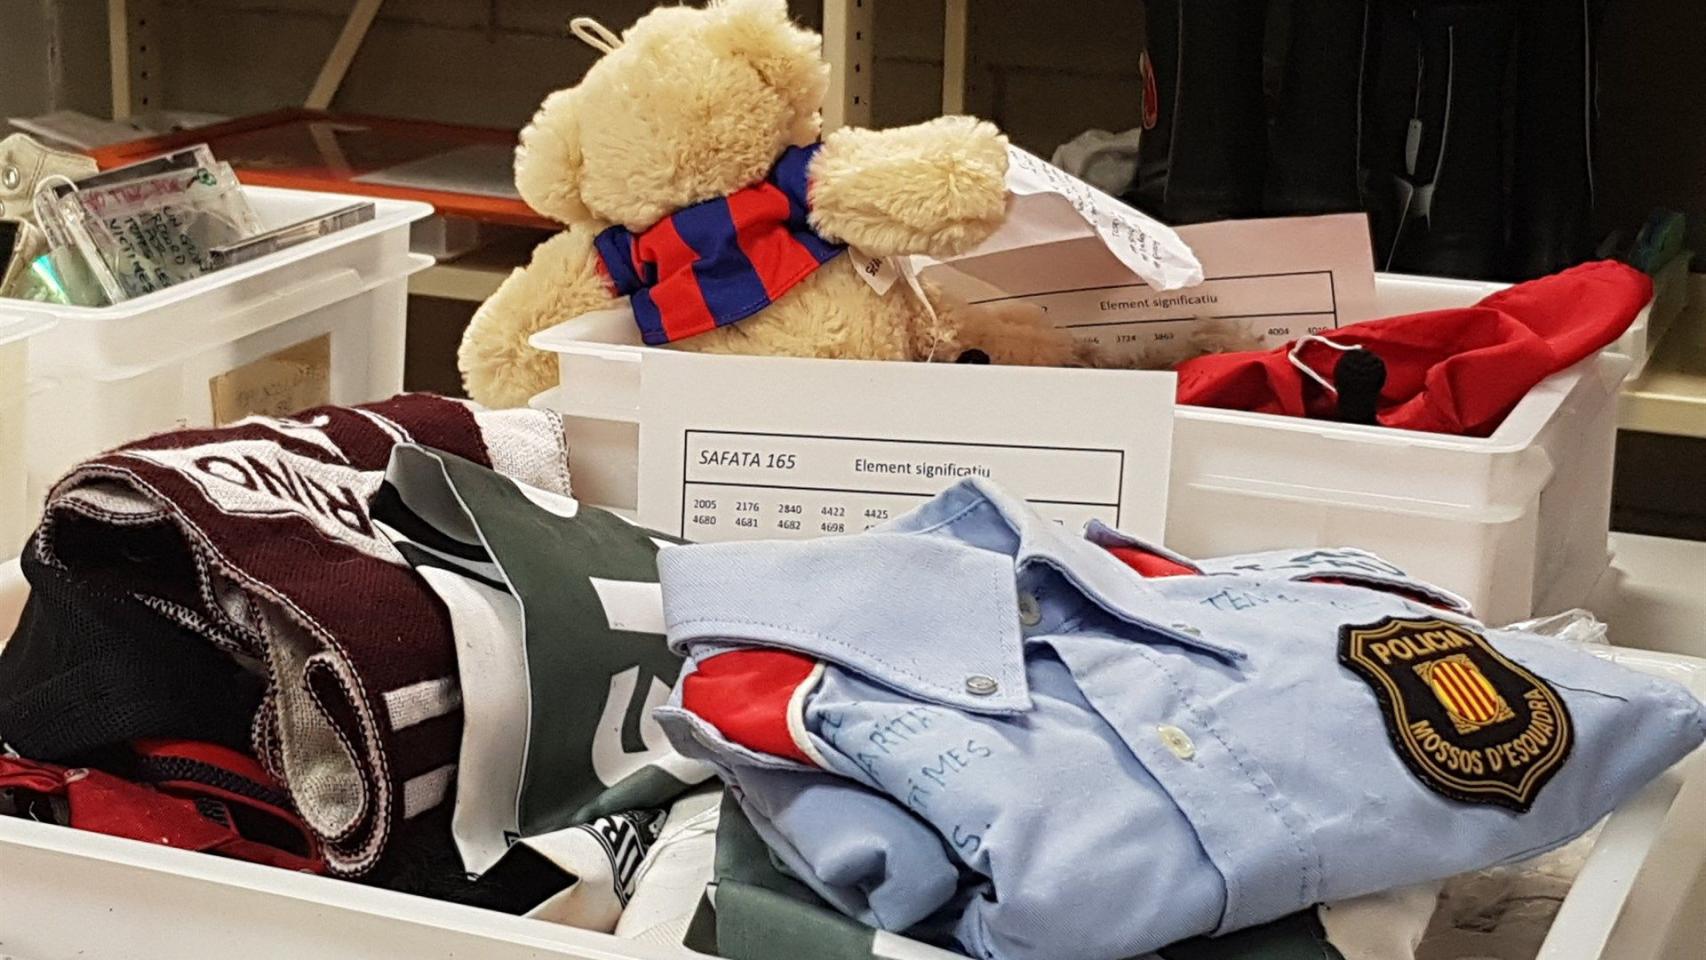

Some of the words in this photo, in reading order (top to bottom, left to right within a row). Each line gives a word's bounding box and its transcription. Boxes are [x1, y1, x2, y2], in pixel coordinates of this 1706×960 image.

[1100, 298, 1149, 311] Element
[1153, 294, 1218, 310] significatiu
[699, 450, 761, 467] SAFATA
[766, 453, 796, 469] 165
[855, 459, 911, 475] Element
[915, 462, 991, 478] significatiu
[694, 499, 717, 510] 2005
[736, 502, 759, 512] 2176
[778, 504, 802, 514] 2840
[821, 507, 845, 517] 4422
[864, 509, 888, 519] 4425
[693, 515, 716, 525] 4680
[735, 517, 758, 528] 4681
[777, 520, 801, 530] 4682
[1369, 629, 1474, 665] POLICIA
[1410, 720, 1484, 775] MOSSOS
[1484, 689, 1555, 773] D'ESQUADRA
